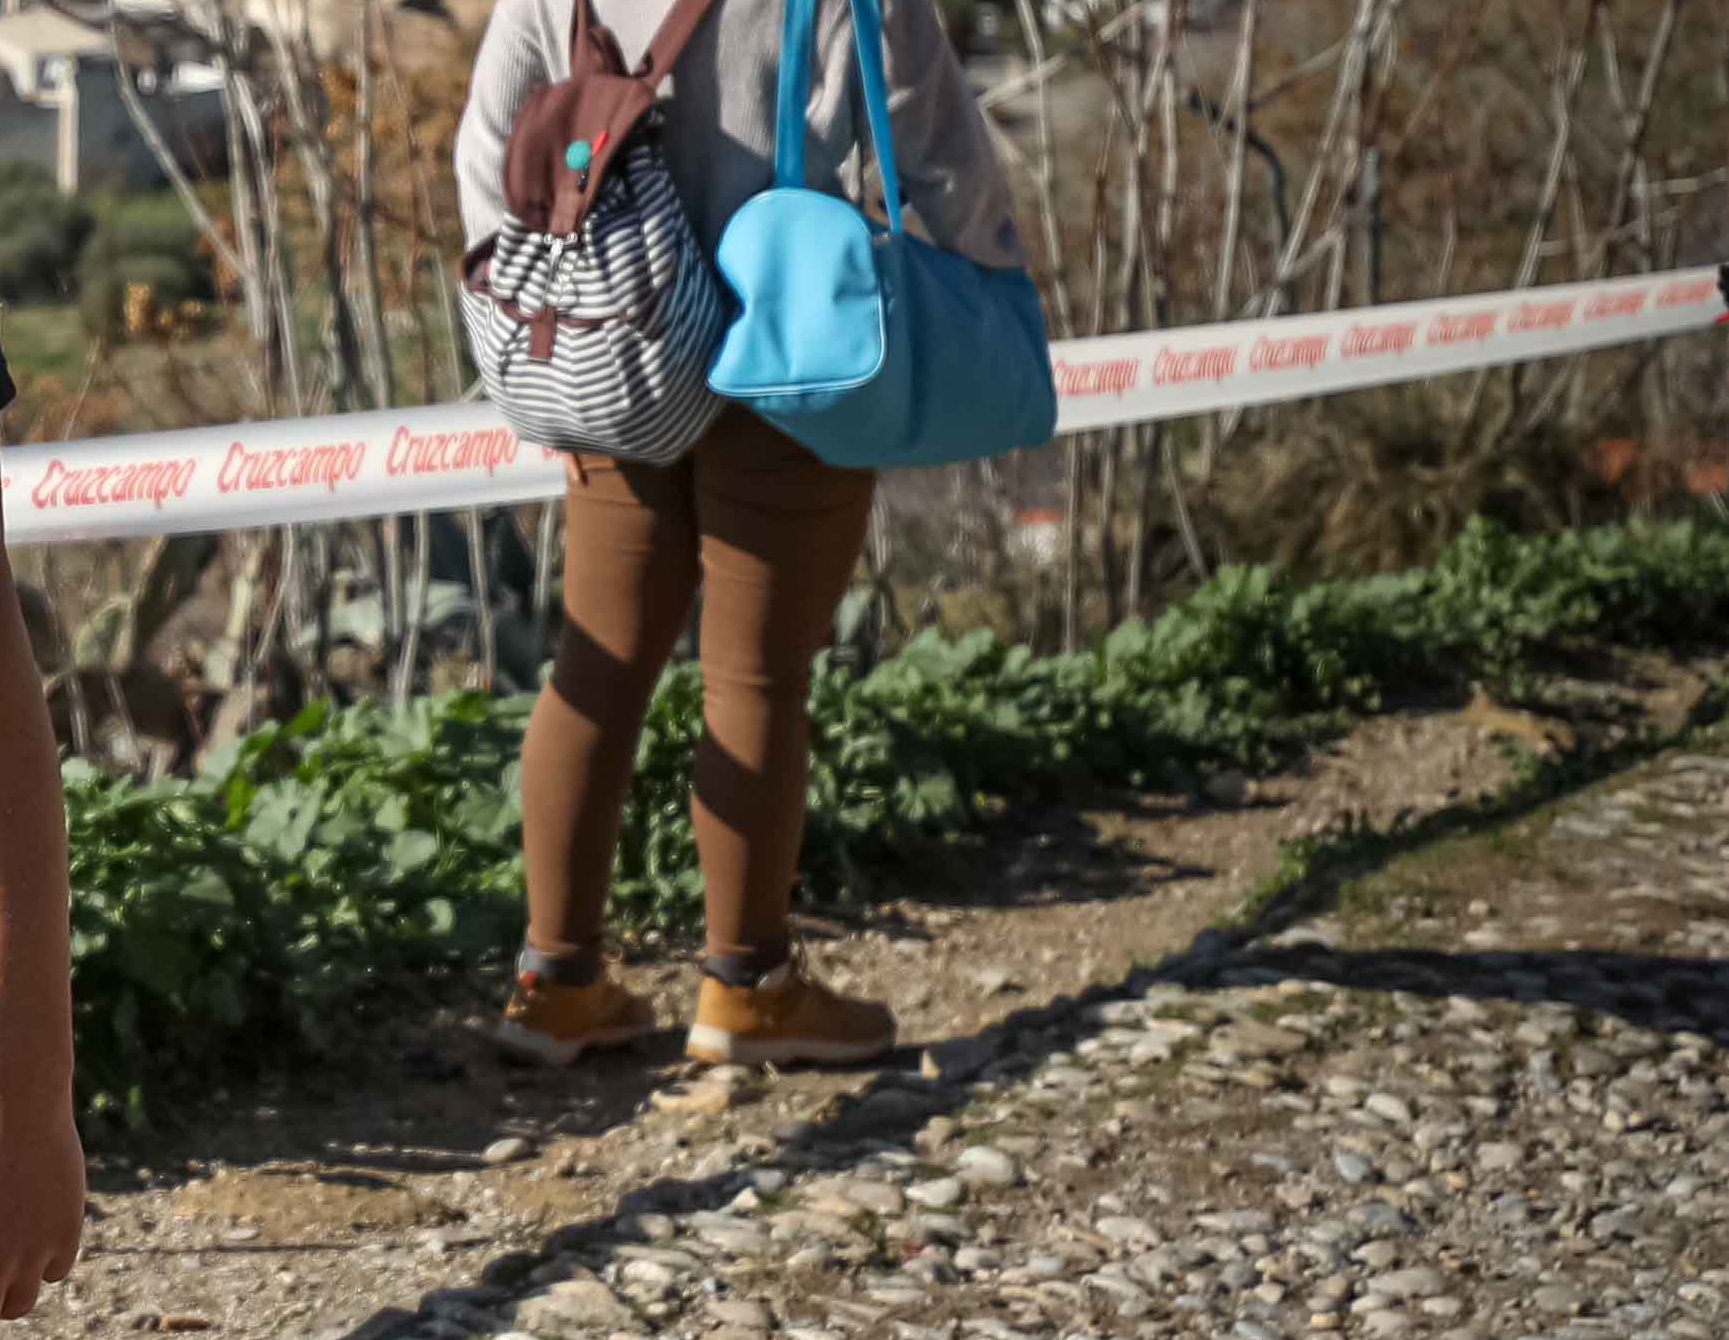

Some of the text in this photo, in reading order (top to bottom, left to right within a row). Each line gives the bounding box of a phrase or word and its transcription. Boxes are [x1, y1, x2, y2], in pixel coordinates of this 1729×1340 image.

[30, 425, 519, 510] Cruzcampo Cruzcampo Cruzcampo
